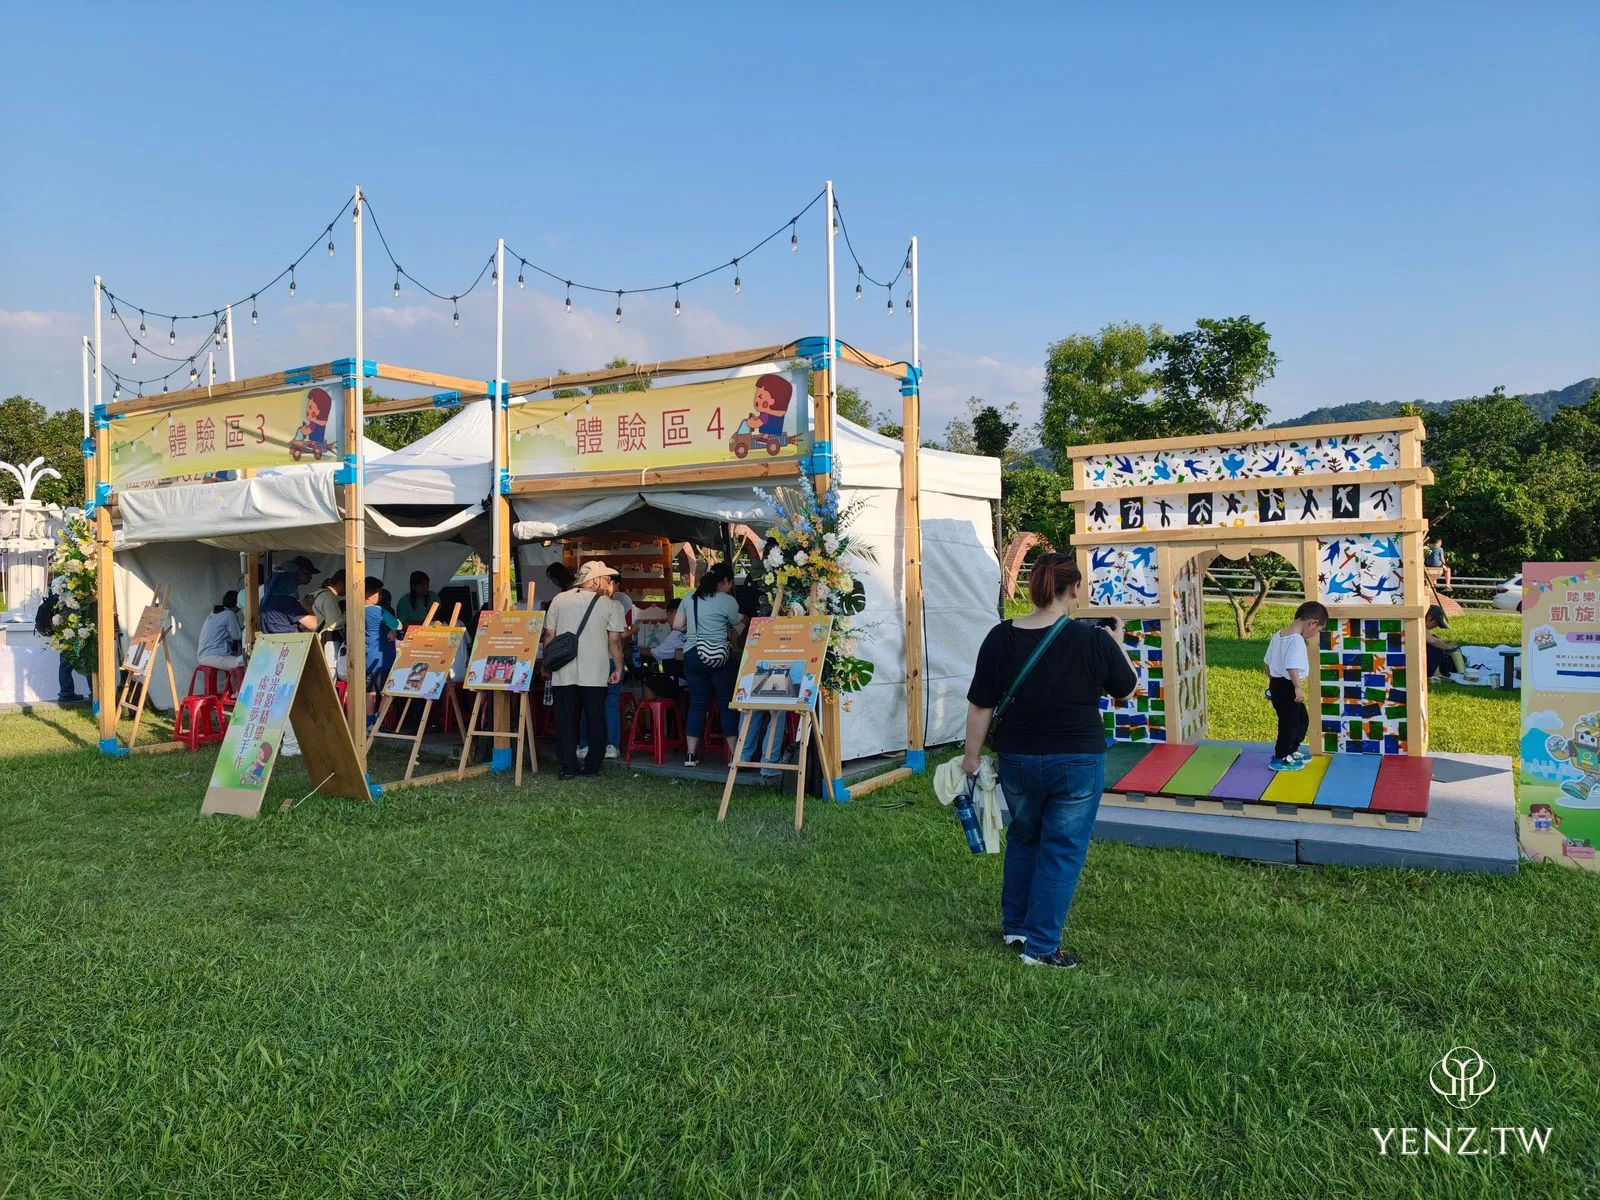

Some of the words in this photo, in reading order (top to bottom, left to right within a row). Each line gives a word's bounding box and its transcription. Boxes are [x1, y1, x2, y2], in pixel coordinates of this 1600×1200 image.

[167, 412, 267, 459] 體驗區3
[575, 406, 725, 456] 體驗區4
[1566, 591, 1600, 602] 踏樂
